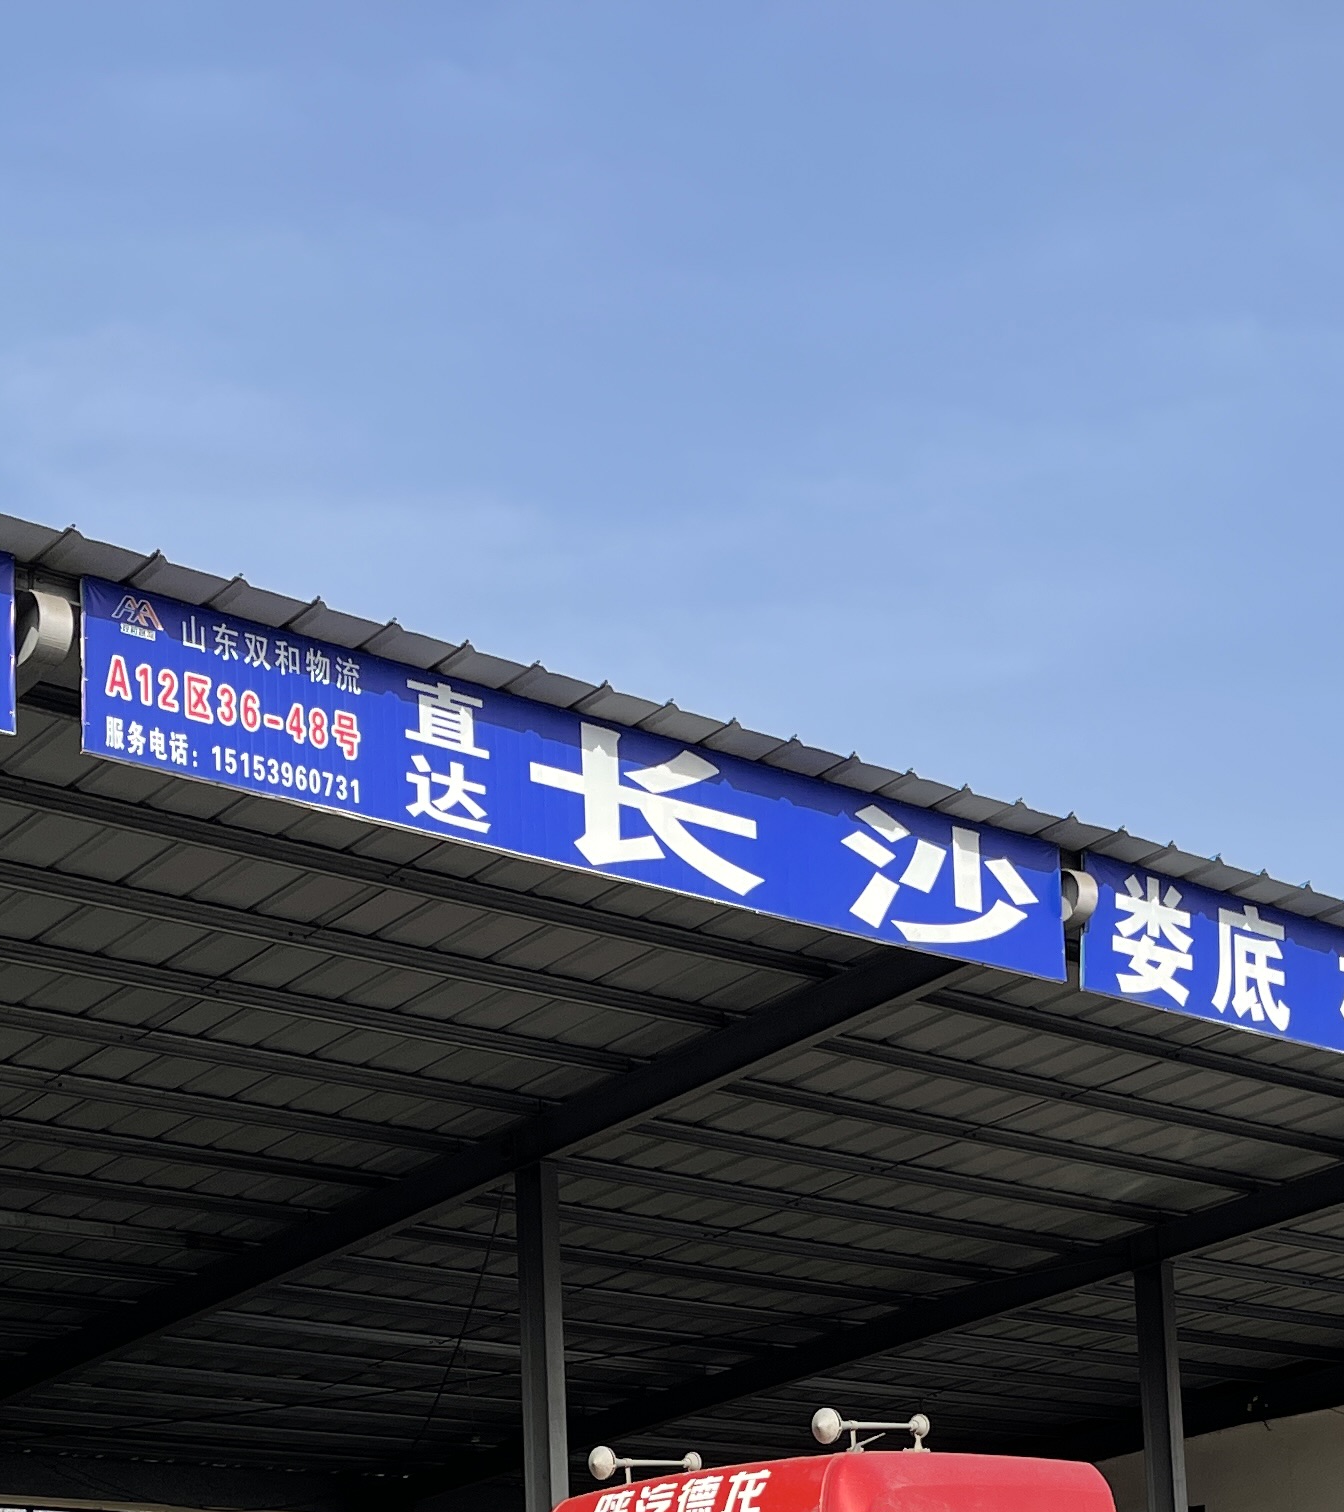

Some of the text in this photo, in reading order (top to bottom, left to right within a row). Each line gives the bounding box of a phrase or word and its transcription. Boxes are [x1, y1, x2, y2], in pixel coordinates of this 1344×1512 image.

[105, 654, 361, 760] A12区36-48号
[181, 615, 361, 695] 山东双和物流
[404, 678, 491, 834] 直达
[529, 721, 1040, 944] 长沙
[1111, 874, 1291, 1033] 娄底
